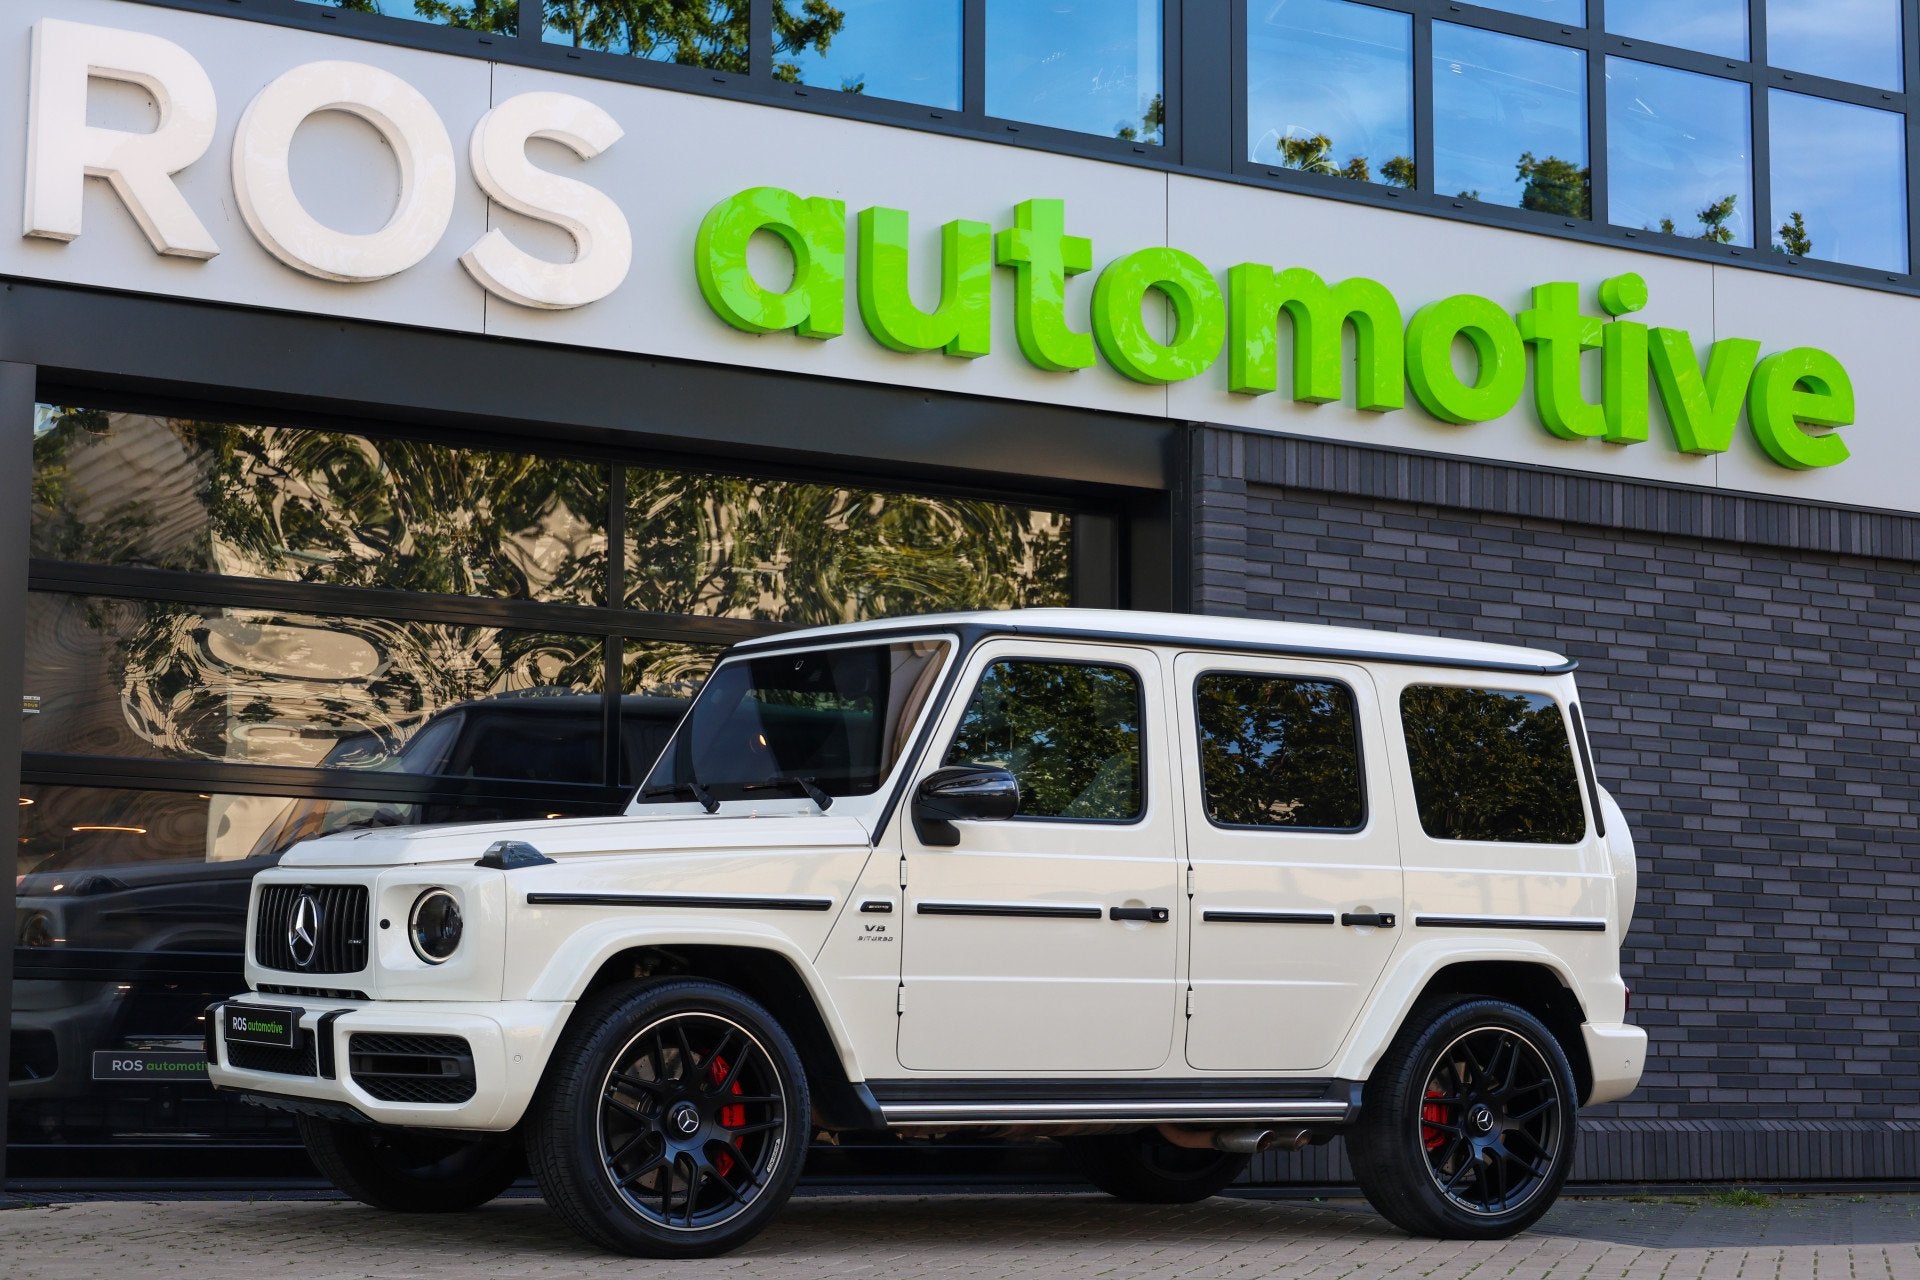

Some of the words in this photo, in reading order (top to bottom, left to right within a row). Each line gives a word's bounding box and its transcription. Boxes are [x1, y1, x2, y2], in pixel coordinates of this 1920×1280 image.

[23, 17, 632, 310] ROS
[695, 187, 1856, 468] automotive
[864, 924, 886, 932] V8
[232, 1016, 247, 1032] ROS
[247, 1020, 283, 1034] automotive
[112, 1060, 144, 1072] ROS
